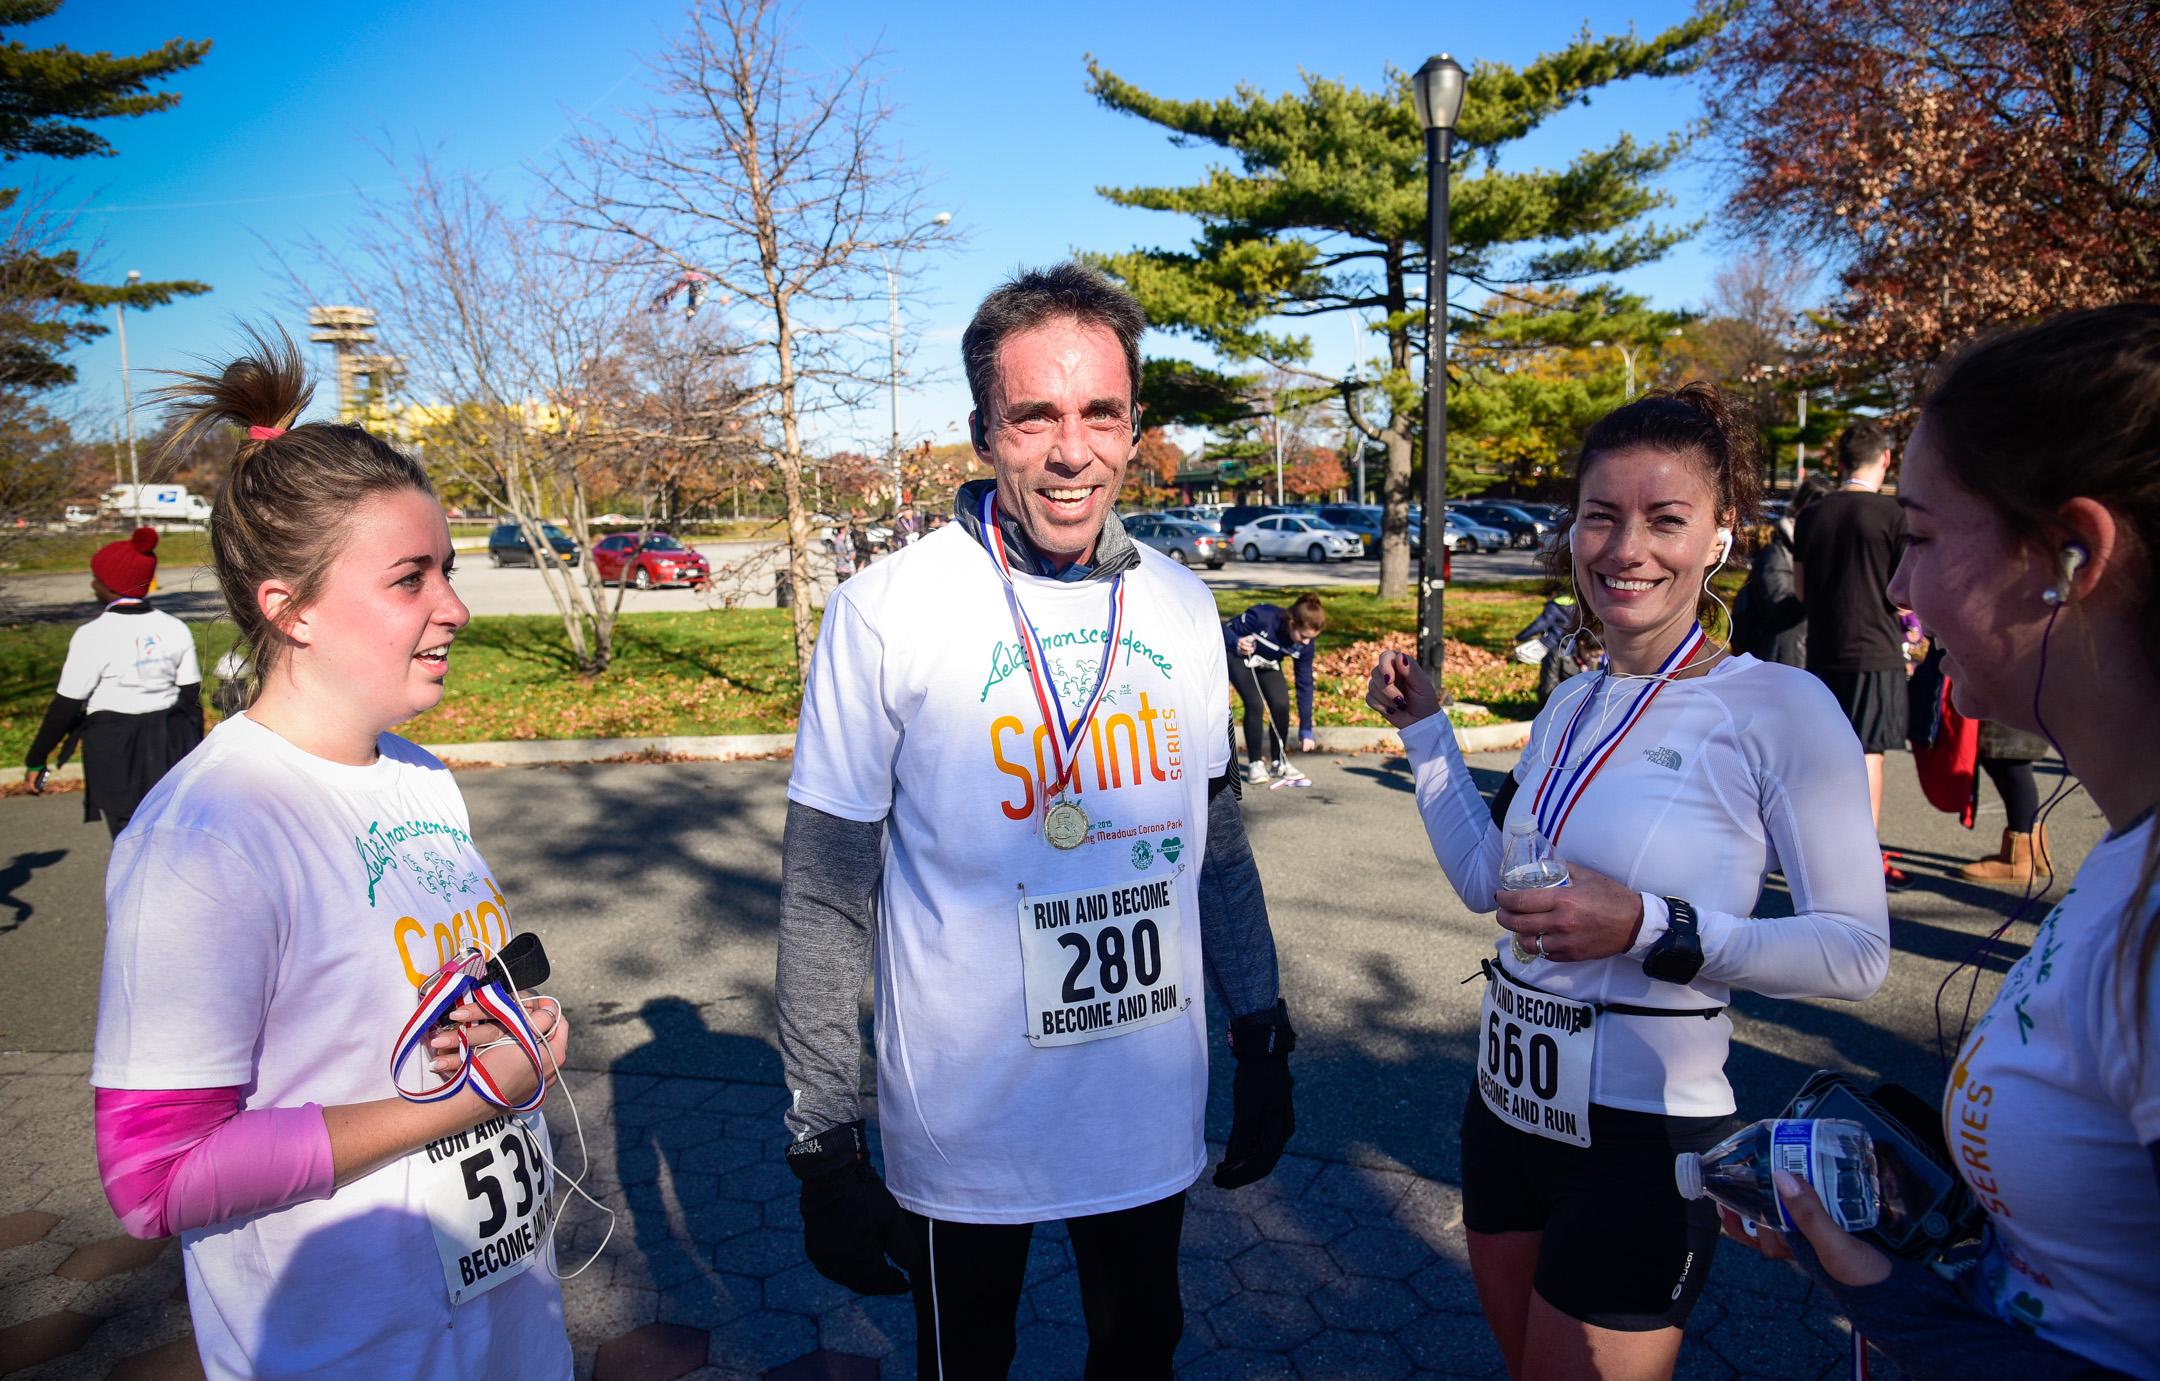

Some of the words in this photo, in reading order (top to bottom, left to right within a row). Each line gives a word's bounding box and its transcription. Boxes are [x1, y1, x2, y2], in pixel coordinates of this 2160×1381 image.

[1162, 708, 1183, 781] SERIES
[1643, 749, 1671, 761] NORTH
[1647, 756, 1667, 767] FACE
[1659, 746, 1673, 756] THE
[1097, 828, 1137, 842] Meadows
[1138, 822, 1165, 835] Corona
[1167, 819, 1183, 831] Park
[1033, 899, 1071, 930] RUN
[1075, 893, 1108, 925] AND
[1111, 880, 1170, 918] BECOME
[1056, 918, 1162, 1004] 280
[1041, 1001, 1113, 1035] BECOME
[1117, 993, 1147, 1024] AND
[1151, 984, 1177, 1014] RUN
[1496, 982, 1514, 1015] AND
[1517, 994, 1582, 1033] BECOME
[1488, 1010, 1559, 1101] 660
[1480, 1066, 1510, 1112] BECOME
[1511, 1094, 1539, 1125] AND
[1545, 1105, 1578, 1136] RUN
[425, 1130, 470, 1164] RUN
[474, 1114, 506, 1145] AND
[1960, 1080, 2012, 1218] SERIES
[460, 1123, 546, 1239] 539
[458, 1222, 535, 1287] BECOME
[1679, 1251, 1694, 1283] SUGOI
